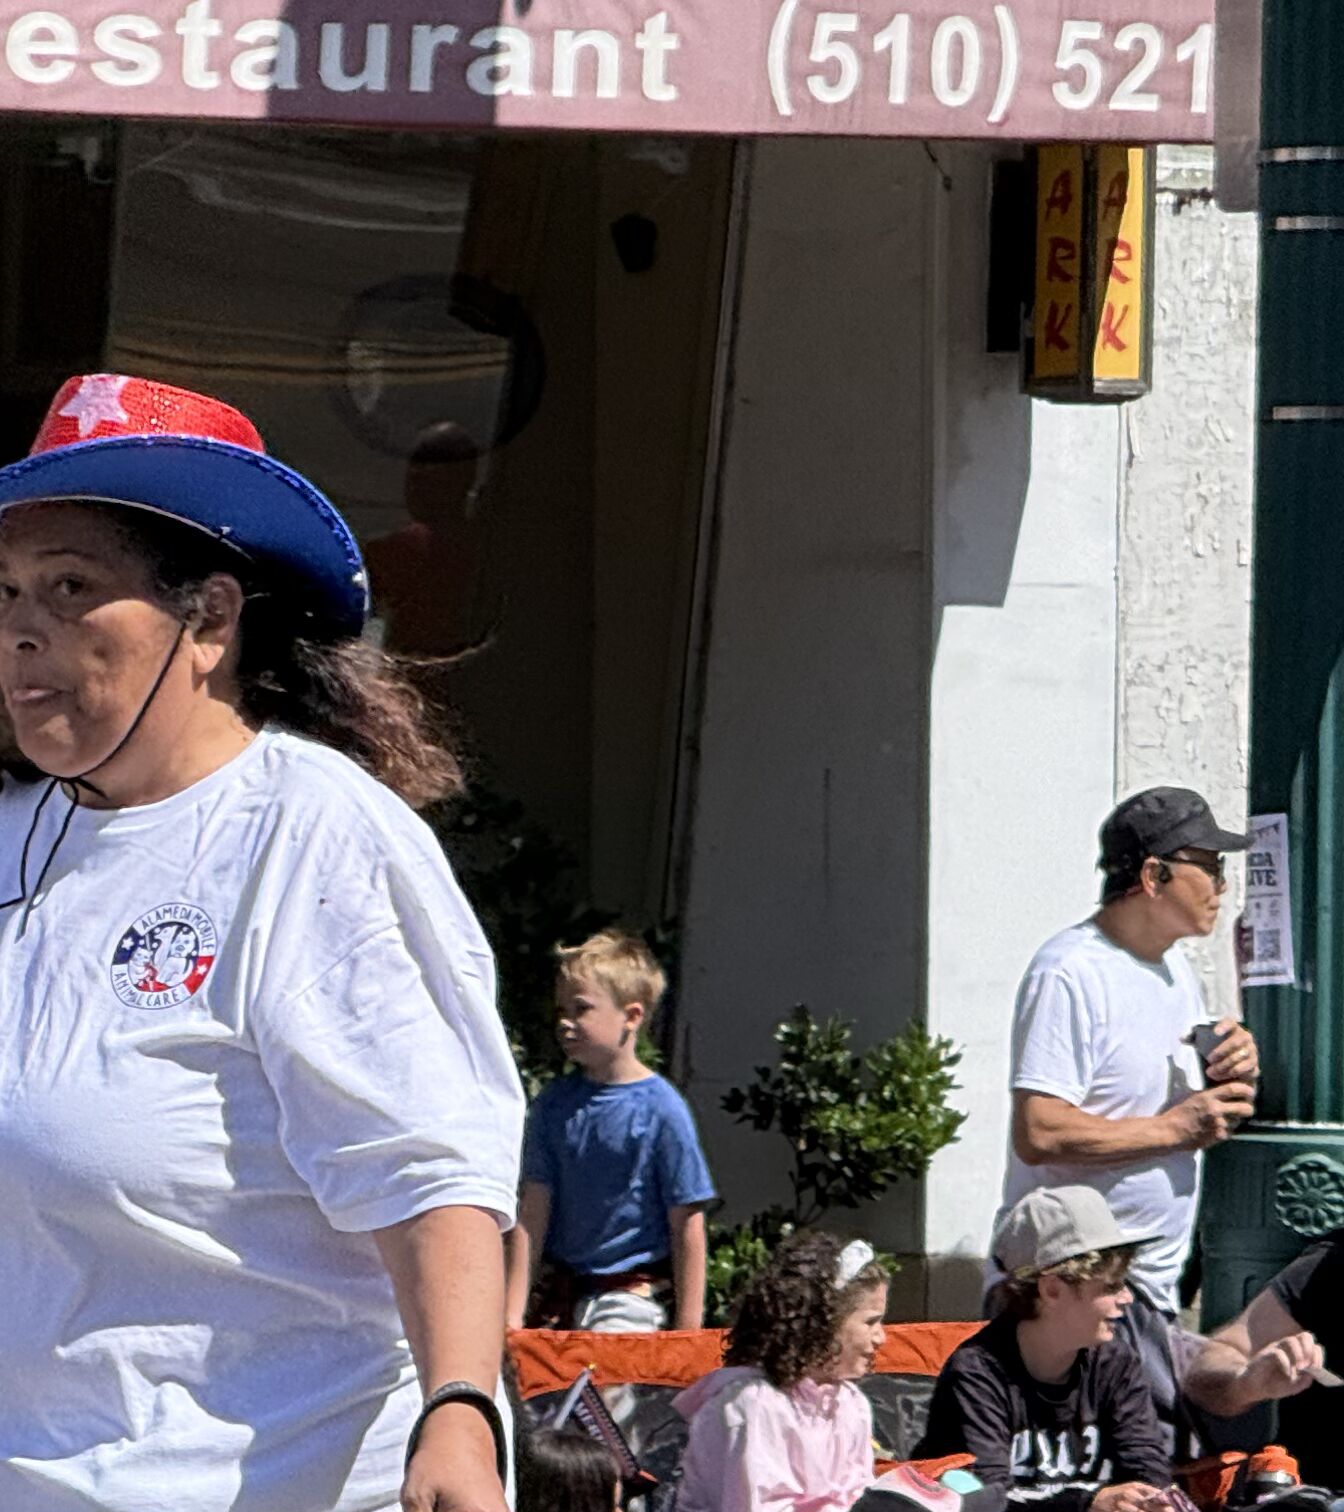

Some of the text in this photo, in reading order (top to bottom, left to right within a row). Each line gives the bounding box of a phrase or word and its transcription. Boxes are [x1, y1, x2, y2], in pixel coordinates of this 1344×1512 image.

[767, 0, 1022, 124] (510)
[1052, 19, 1213, 114] 521
[1045, 168, 1078, 352] ARK
[1100, 170, 1134, 352] ARK
[115, 973, 180, 1007] ANIMAL CARE
[140, 906, 215, 950] ALAMEDA MOBILE
